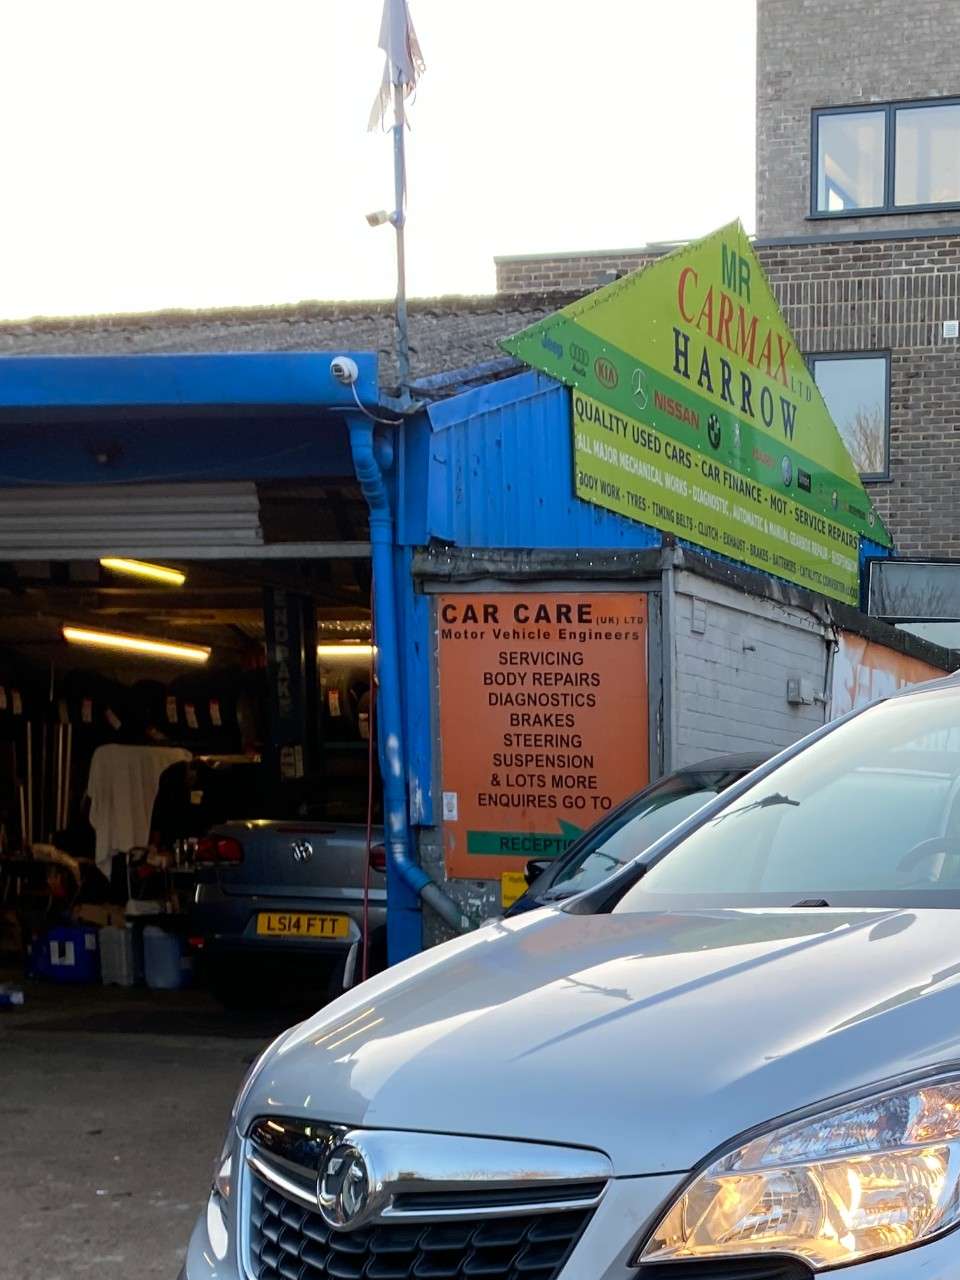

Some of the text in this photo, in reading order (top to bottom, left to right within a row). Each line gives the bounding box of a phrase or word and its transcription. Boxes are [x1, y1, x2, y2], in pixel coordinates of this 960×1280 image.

[721, 242, 750, 302] MR
[678, 267, 791, 388] CARMAX
[673, 327, 797, 441] HARROW
[654, 390, 700, 430] NISSAN
[575, 397, 628, 438] QUALITY
[632, 425, 661, 454] USED
[664, 441, 692, 469] CARS
[701, 460, 720, 483] CAR
[723, 470, 762, 504] FINANCE
[770, 493, 788, 516] MOT
[795, 507, 826, 536] SERVICE
[828, 522, 858, 550] REPAIRS
[593, 440, 619, 467] MAJOR
[619, 451, 663, 487] MECHANICAL
[664, 472, 688, 497] WORKS
[579, 472, 598, 490] BODY
[600, 479, 620, 500] WORK
[627, 491, 646, 511] TYRES
[652, 502, 674, 523] TIMING
[676, 509, 693, 529] BELTS
[698, 521, 719, 542] CLUTCH
[442, 604, 500, 624] CAR
[513, 604, 593, 624] CARE
[624, 616, 644, 625] LTD
[441, 628, 640, 642] Motor Vehicle Engineers
[498, 651, 584, 666] SERVICING
[483, 672, 601, 686] BODY REPAIRS
[488, 692, 596, 707] DIAGNOSTICS
[510, 713, 575, 727] BRAKES
[503, 733, 583, 748] STEERING
[493, 754, 594, 769] SUSPENSION
[491, 774, 598, 790] & LOTS MORE
[478, 793, 612, 810] ENQUIRES GO TO
[267, 915, 339, 935] LS14 FTT
